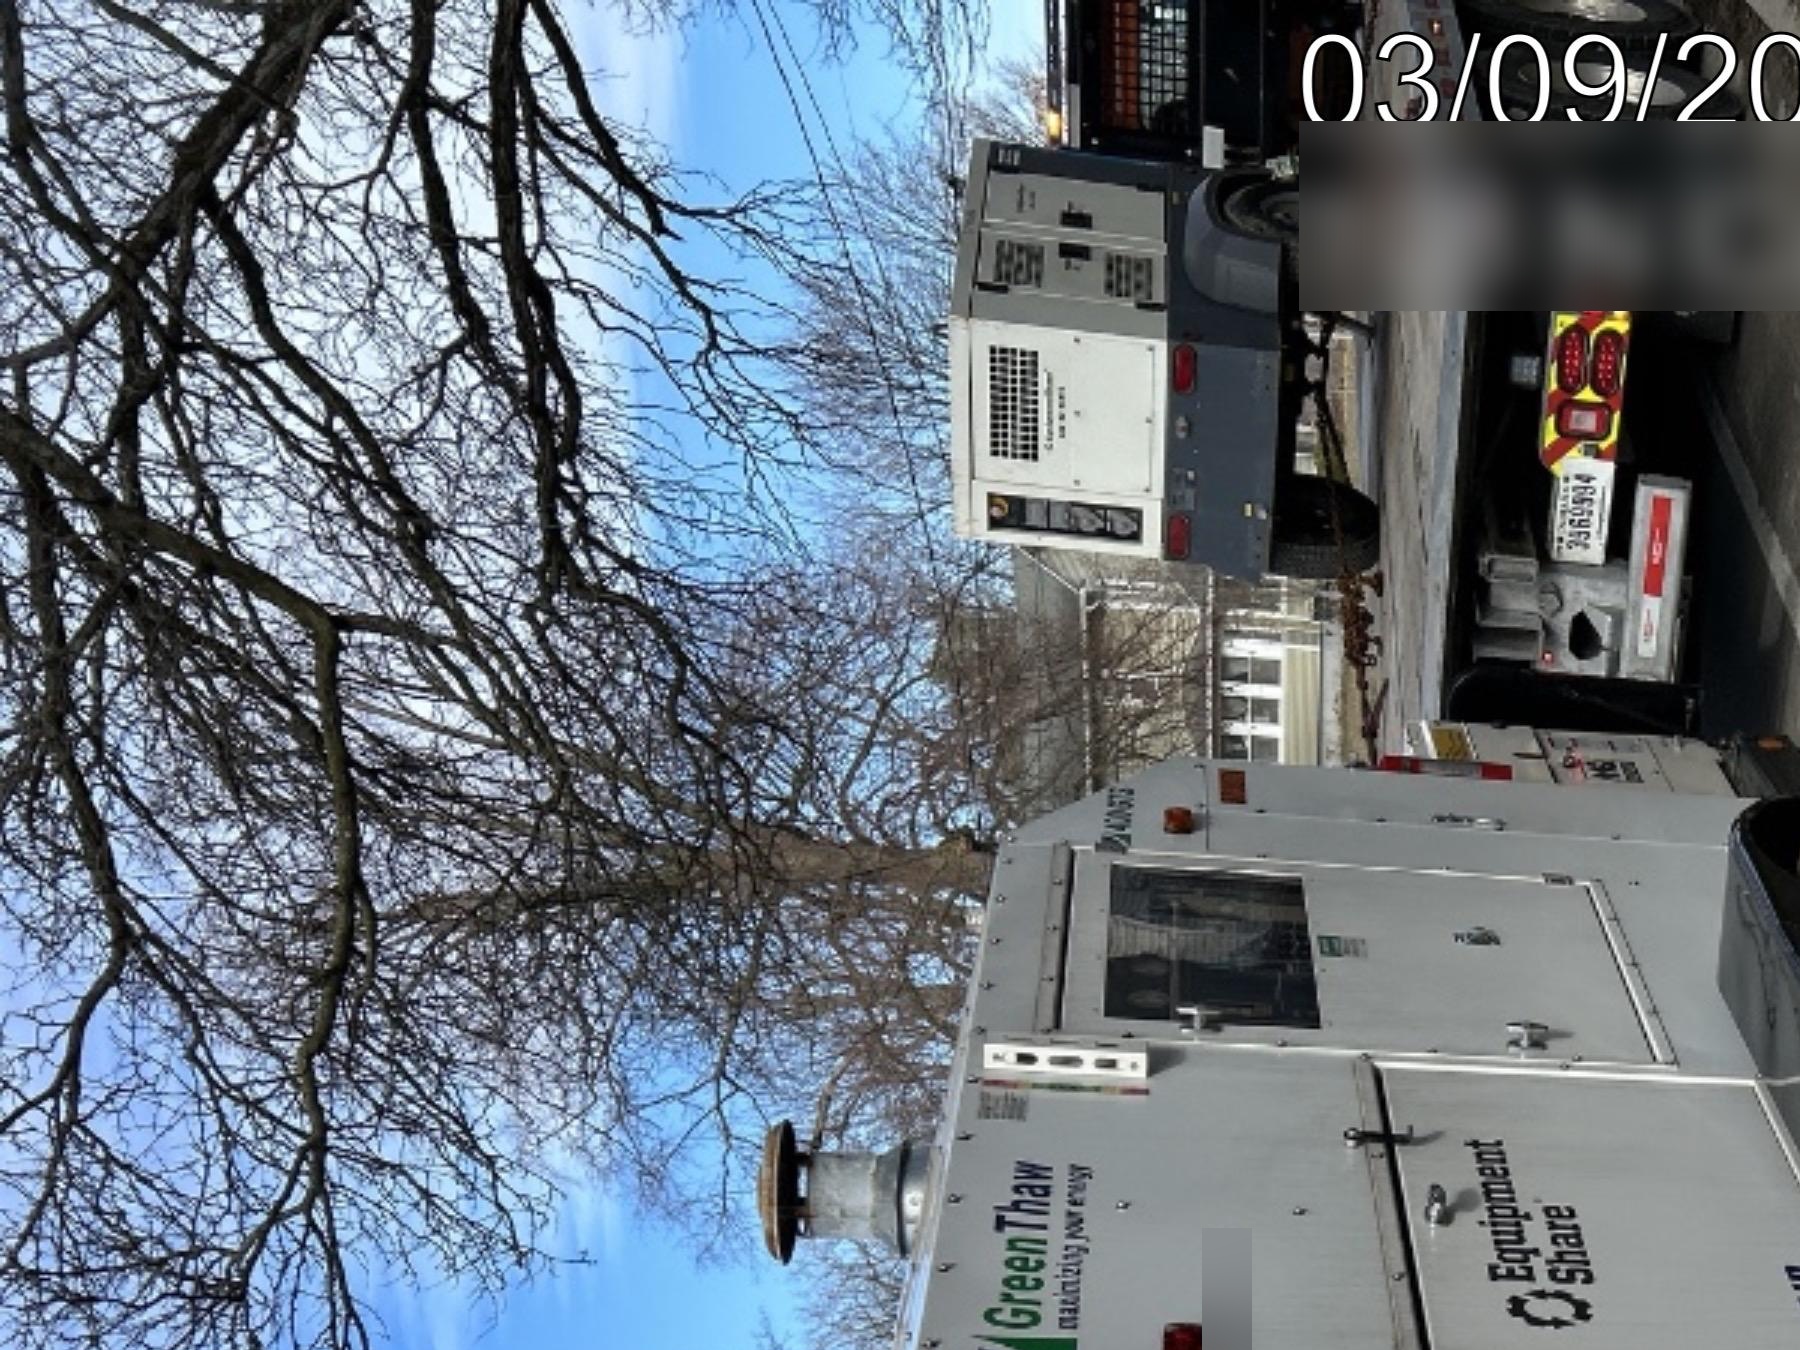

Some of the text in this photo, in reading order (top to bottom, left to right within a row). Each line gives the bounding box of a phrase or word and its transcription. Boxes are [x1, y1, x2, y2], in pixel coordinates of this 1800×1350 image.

[1053, 1163, 1094, 1331] maximizing your energy
[1464, 1139, 1541, 1282] Equipment
[1542, 1205, 1595, 1285] Share
